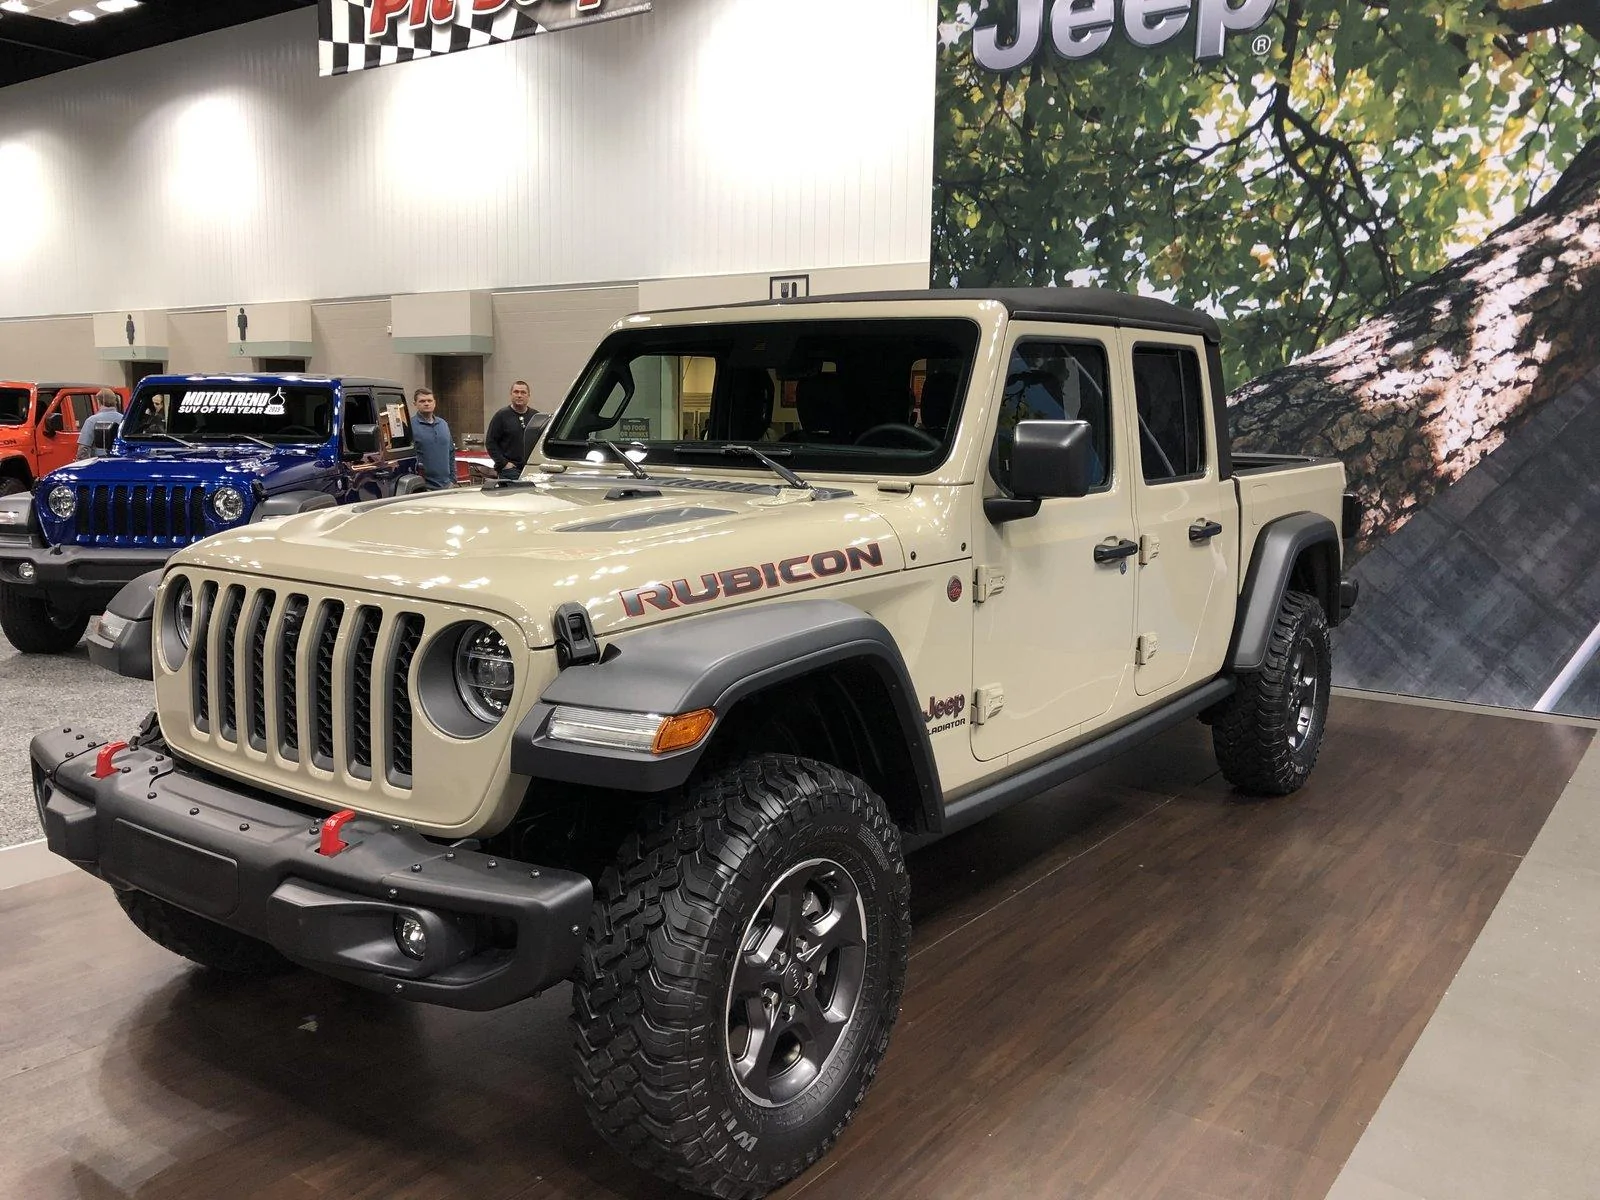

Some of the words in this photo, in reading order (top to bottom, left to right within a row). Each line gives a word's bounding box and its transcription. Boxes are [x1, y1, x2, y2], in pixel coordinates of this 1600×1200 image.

[972, 0, 1276, 70] Jeep
[178, 406, 200, 414] SUV
[200, 406, 215, 414] OF
[216, 406, 237, 414] THE
[237, 406, 263, 414] YEAR
[181, 391, 271, 407] MOTORTREND
[618, 542, 884, 617] RUBICON
[922, 693, 965, 722] Jeep
[927, 718, 966, 735] LADIATOR
